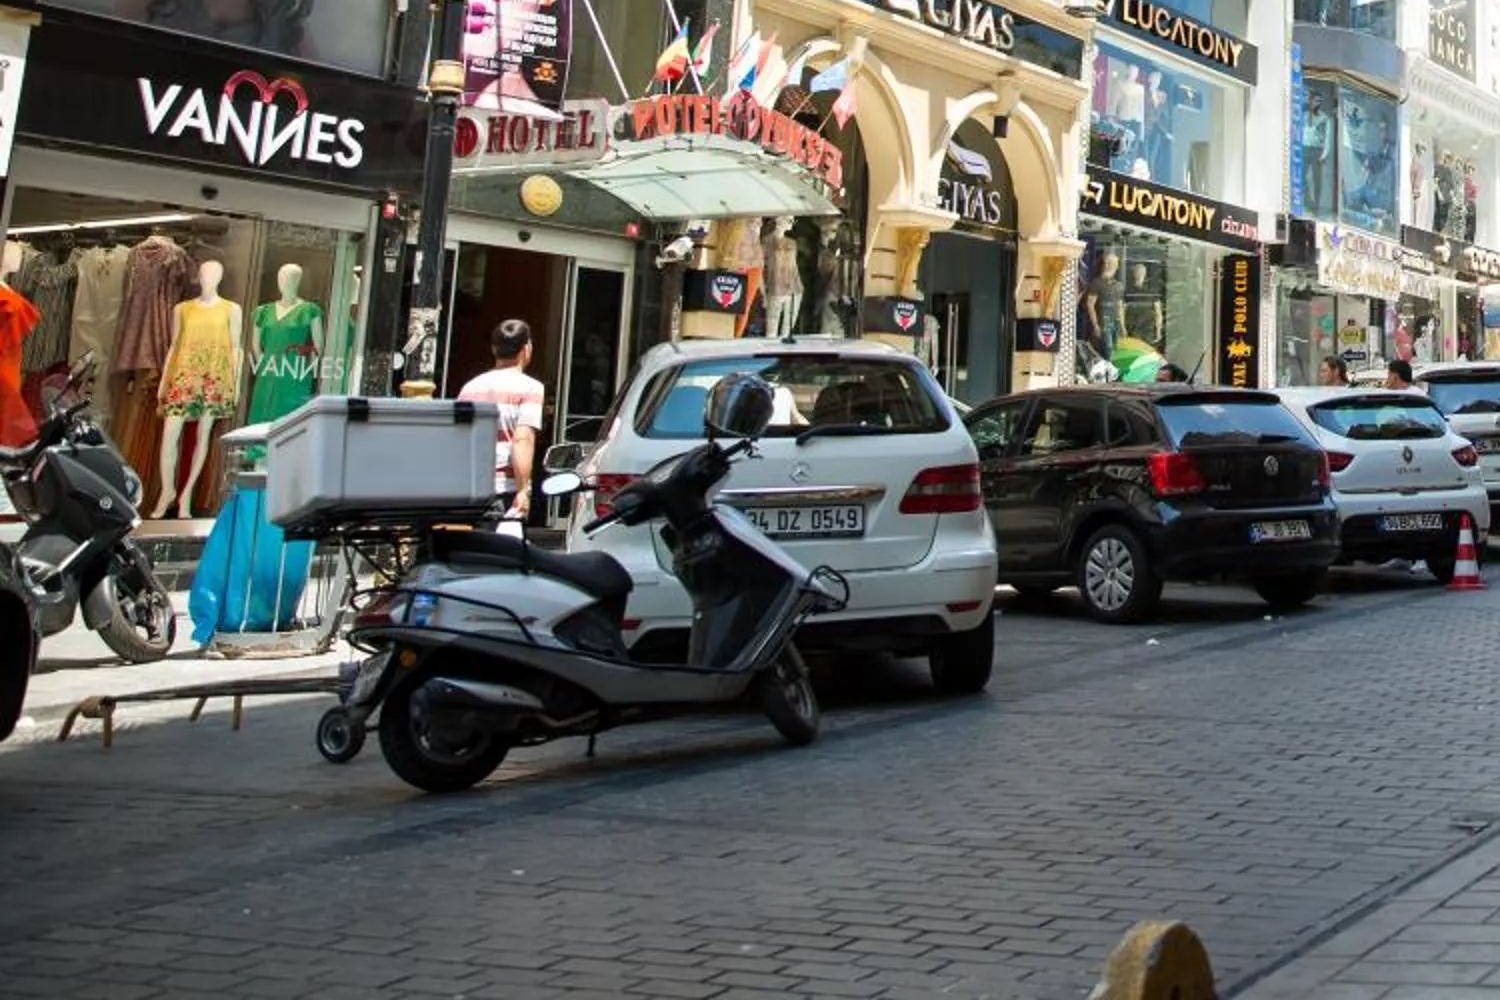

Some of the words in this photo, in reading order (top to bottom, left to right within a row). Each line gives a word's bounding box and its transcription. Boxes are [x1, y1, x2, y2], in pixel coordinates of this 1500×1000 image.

[137, 76, 365, 168] VANNES
[486, 109, 597, 155] HOTEL
[1109, 181, 1217, 231] LUCATONY
[1234, 260, 1248, 292] CLUB
[1233, 297, 1248, 333] POLO
[777, 510, 801, 531] DZ
[811, 509, 858, 530] 0549
